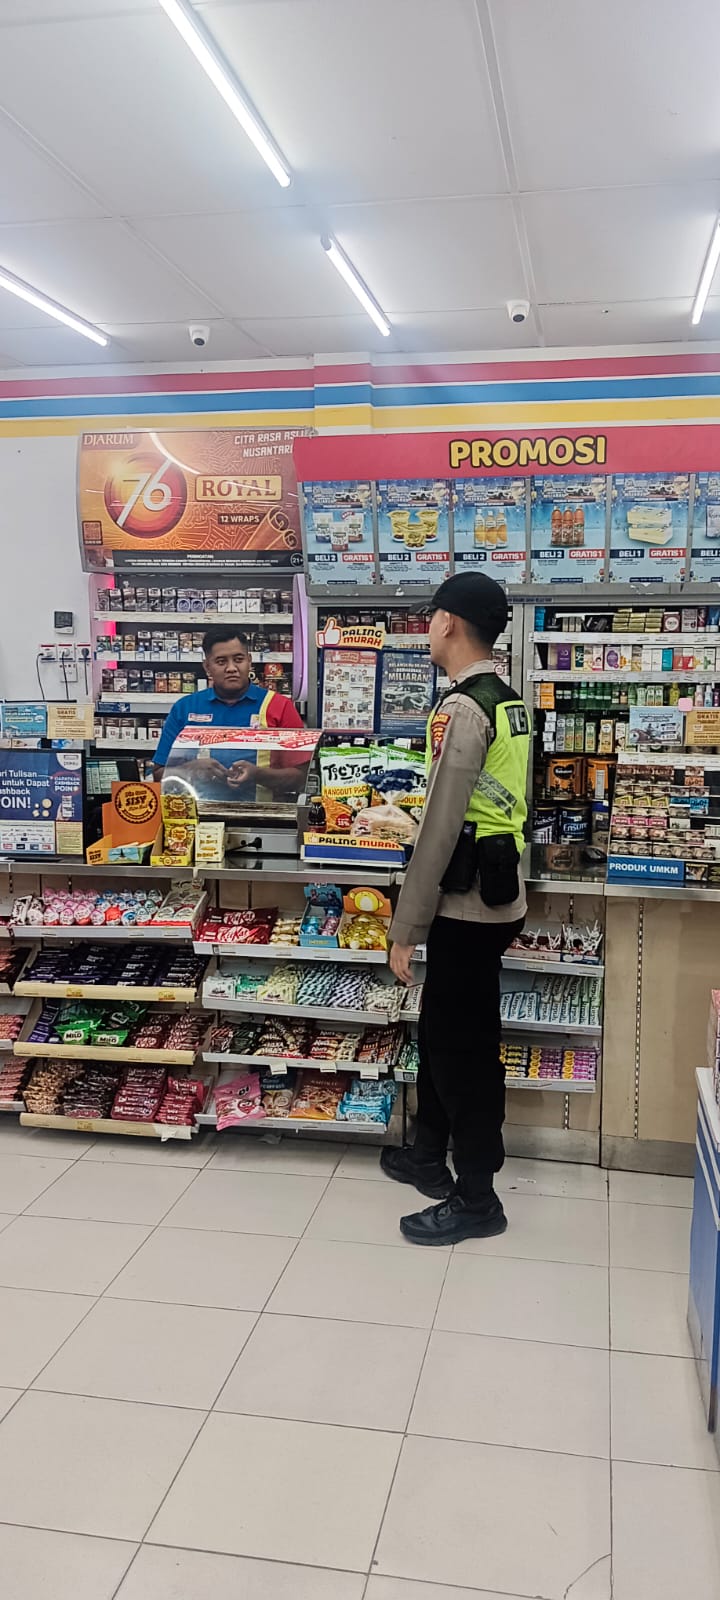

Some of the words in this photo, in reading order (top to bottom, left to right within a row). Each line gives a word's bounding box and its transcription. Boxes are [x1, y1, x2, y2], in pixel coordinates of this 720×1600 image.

[83, 434, 134, 446] DJARUM
[234, 435, 257, 445] CITA
[258, 432, 281, 443] RASA
[449, 435, 607, 469] PROMOSI
[116, 457, 173, 528] 76
[201, 479, 276, 497] ROYAL
[220, 515, 228, 523] 12
[230, 515, 259, 523] WRAPS
[314, 554, 330, 562] BELI
[462, 553, 479, 561] BELI
[570, 550, 597, 558] GRATIS
[650, 549, 679, 557] GRATIS
[342, 628, 383, 638] PALING
[343, 636, 382, 647] MURAH
[8, 769, 38, 778] Tulisan
[26, 779, 50, 788] Dapat
[318, 836, 357, 846] PALING
[359, 839, 399, 849] MURAH
[609, 863, 647, 872] PRODUK
[649, 864, 679, 874] UMKM
